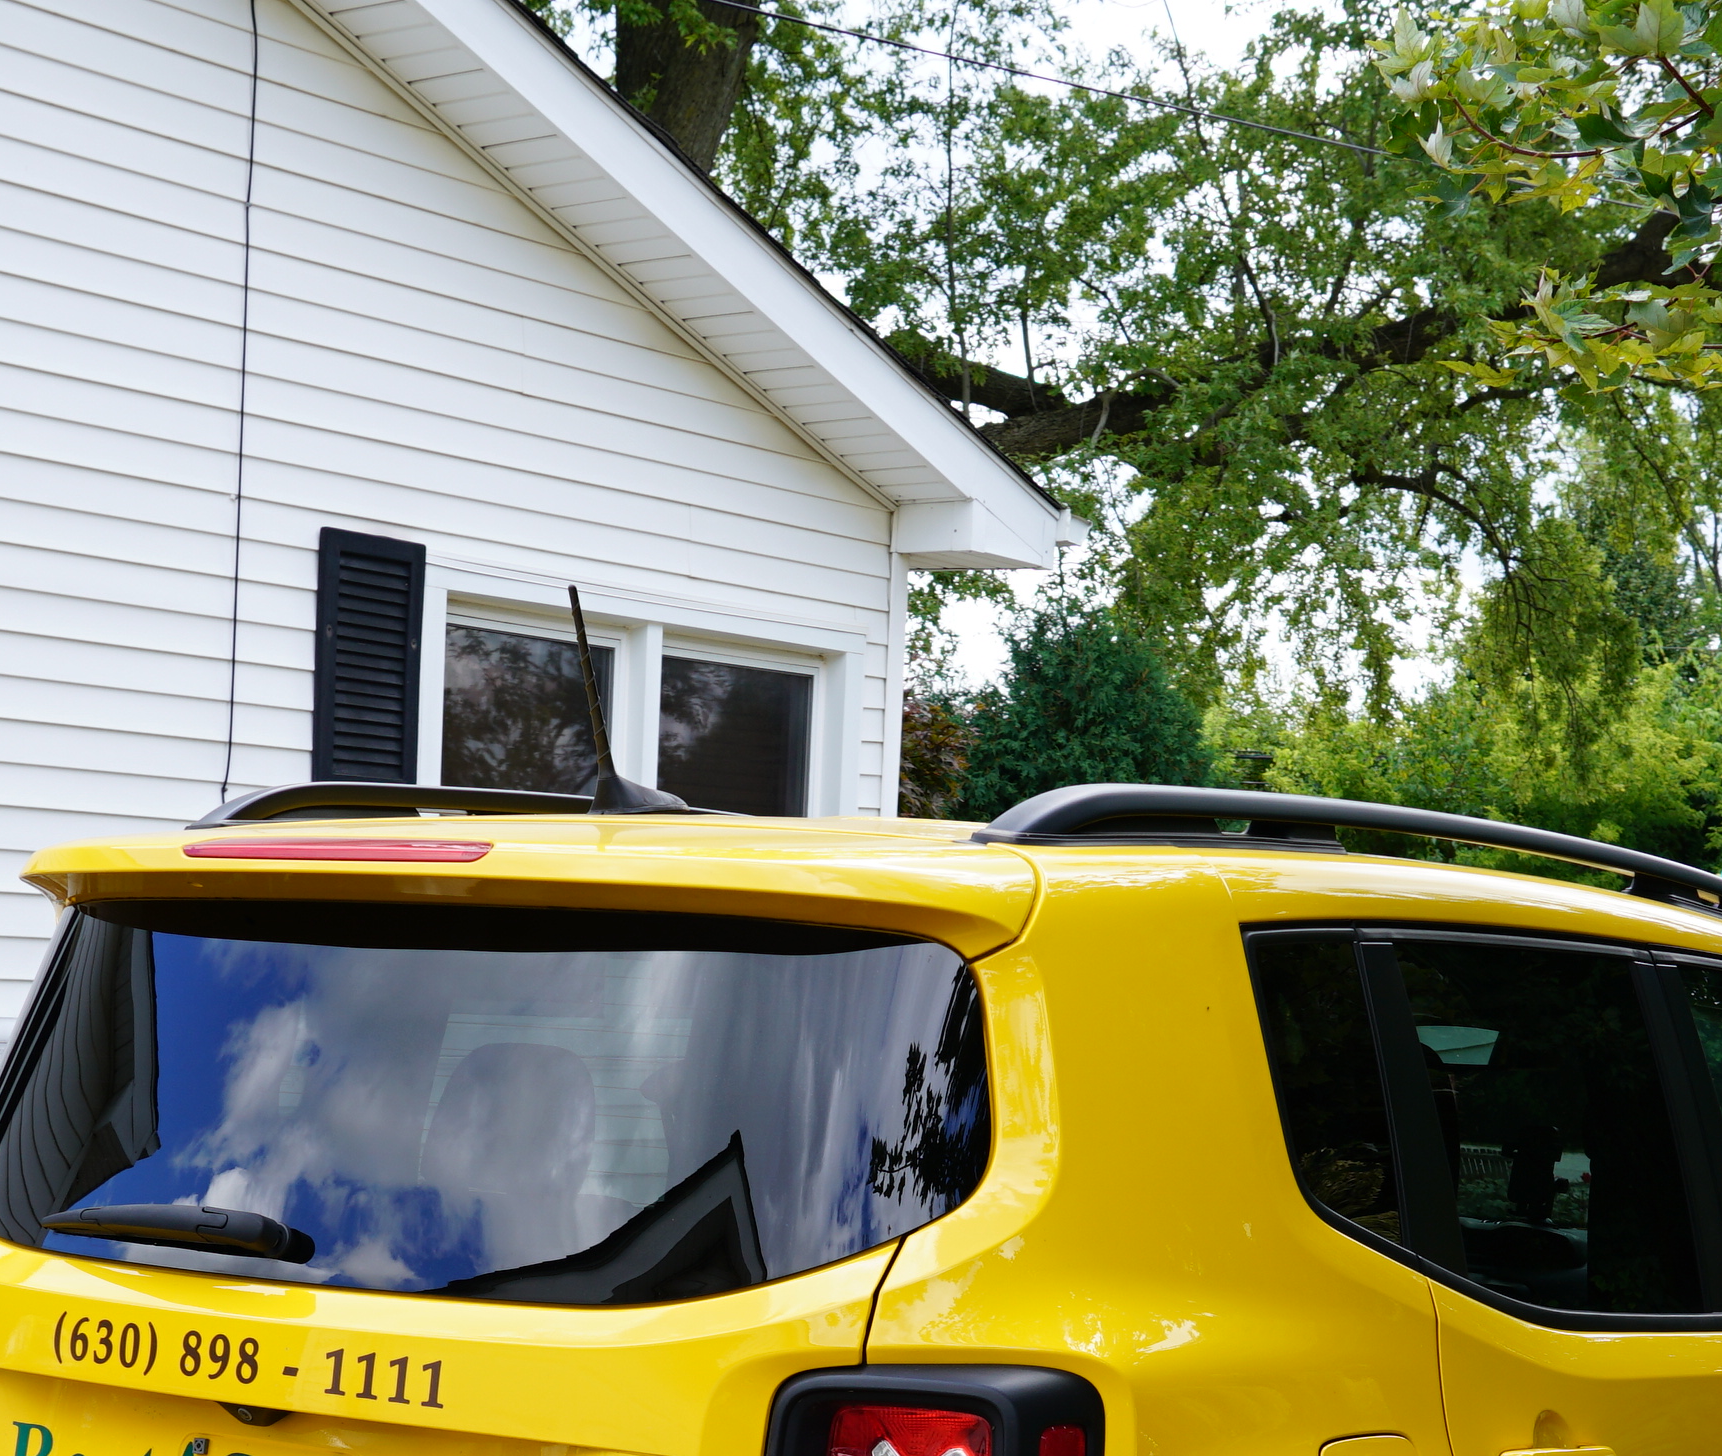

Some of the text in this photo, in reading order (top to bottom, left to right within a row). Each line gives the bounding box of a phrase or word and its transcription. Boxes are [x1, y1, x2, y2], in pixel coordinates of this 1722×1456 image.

[54, 1311, 446, 1410] (630) 898 - 1111
